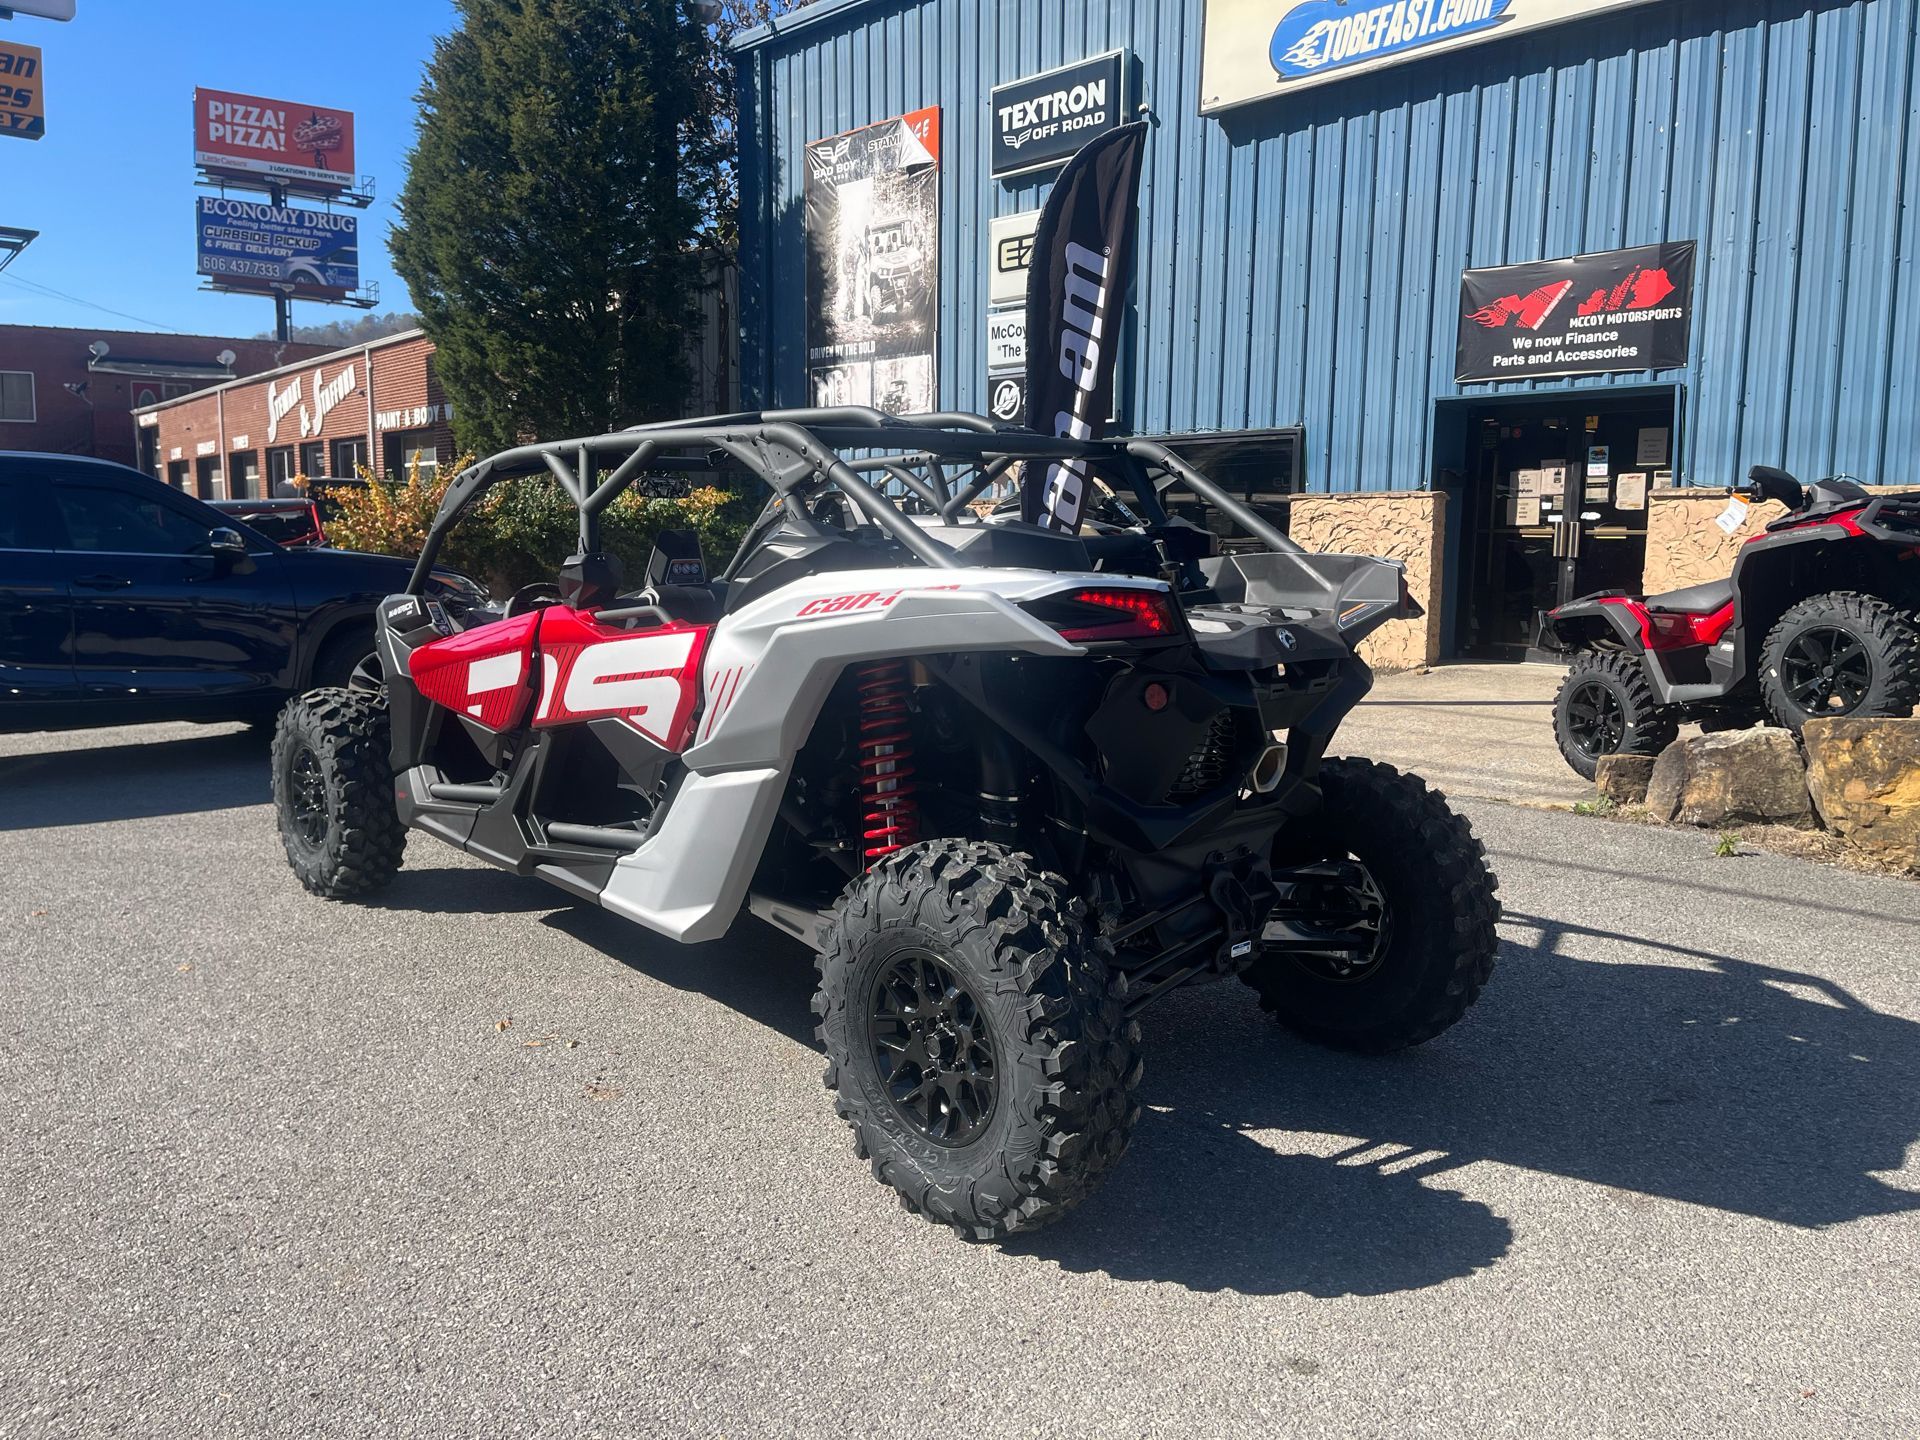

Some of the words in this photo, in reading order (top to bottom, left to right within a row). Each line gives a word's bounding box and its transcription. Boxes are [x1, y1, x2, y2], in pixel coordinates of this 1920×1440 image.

[208, 99, 286, 131] PIZZA!
[998, 78, 1106, 133] TEXTRON
[208, 121, 287, 152] PIZZA!
[1032, 122, 1059, 140] OFF
[1062, 111, 1106, 133] ROAD
[868, 133, 902, 153] STAM
[274, 165, 307, 176] LOCATIONS
[813, 166, 834, 180] BAD
[836, 159, 857, 174] BOY
[202, 197, 303, 226] ECONOMY
[303, 211, 355, 233] DRUG
[204, 225, 271, 244] CURBSIDE
[273, 233, 321, 249] PICKUP
[227, 217, 259, 230] Feeling
[260, 221, 286, 233] better
[287, 225, 311, 236] starts
[205, 239, 213, 248] &
[215, 240, 242, 251] FREE
[245, 243, 294, 257] DELIVERY
[1569, 314, 1606, 328] MCCOY
[1606, 307, 1683, 325] MOTORSPORTS
[810, 344, 834, 360] DRIVEN
[845, 341, 857, 356] THE
[858, 340, 876, 354] BOLD
[1512, 337, 1532, 350] We
[1535, 335, 1562, 348] now
[1565, 331, 1619, 345] Finance
[1493, 355, 1525, 367] Parts
[1528, 352, 1552, 365] and
[1555, 345, 1638, 362] Accessories
[300, 405, 311, 438] &
[375, 410, 401, 430] PAINT
[404, 408, 411, 427] &
[413, 405, 440, 426] BODY
